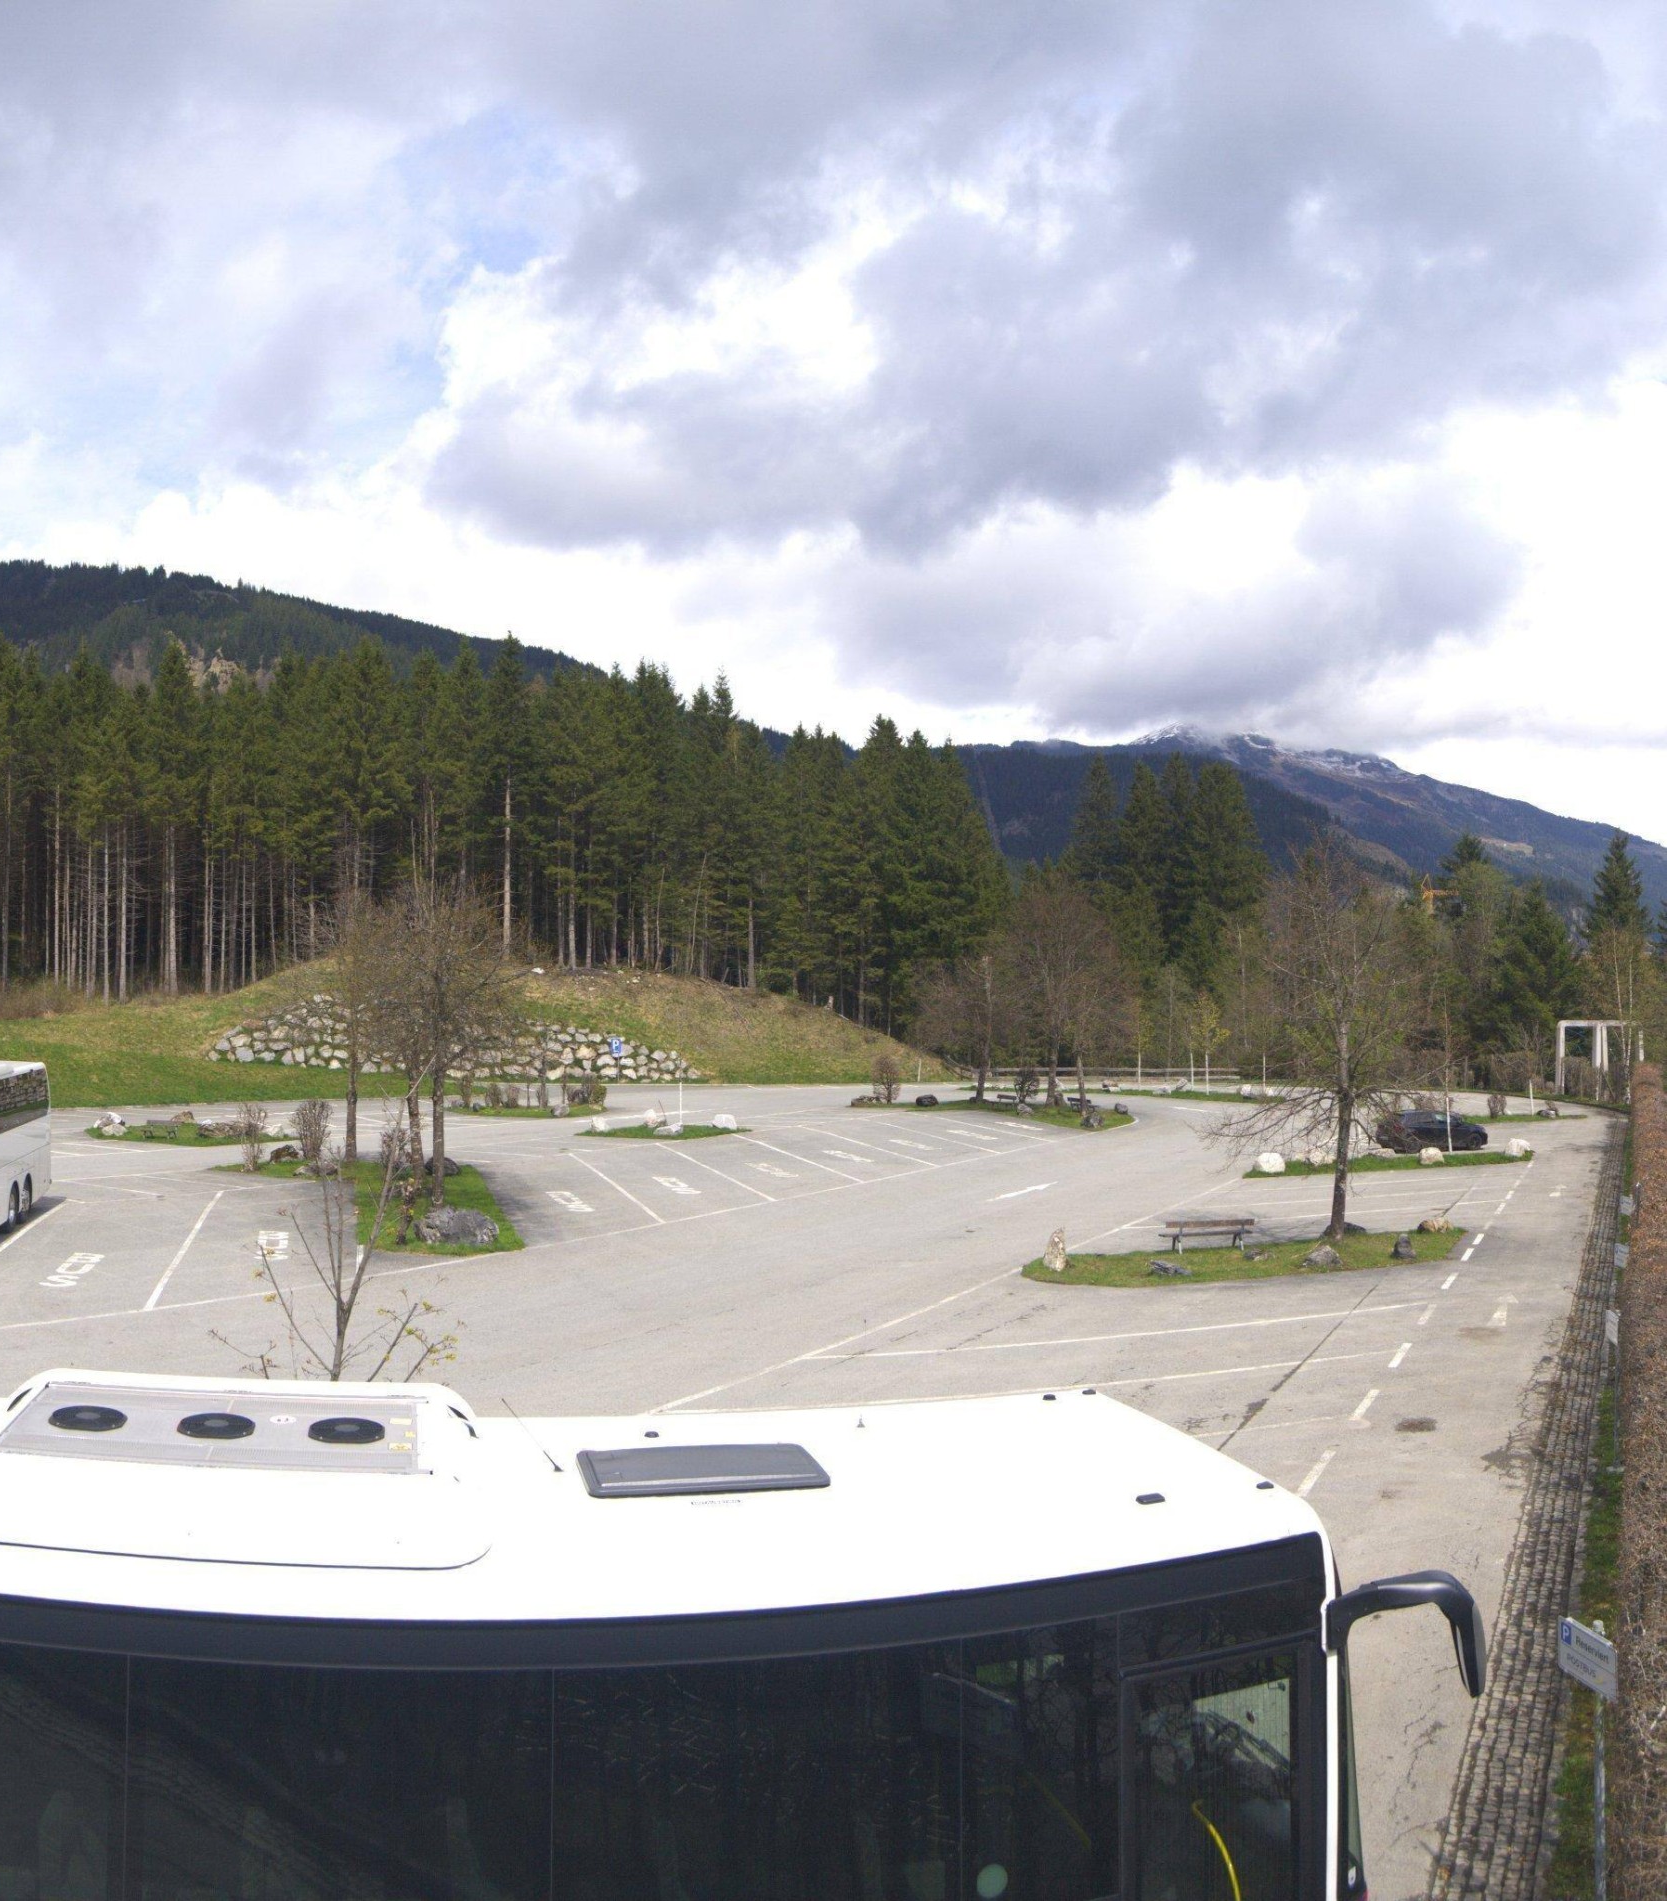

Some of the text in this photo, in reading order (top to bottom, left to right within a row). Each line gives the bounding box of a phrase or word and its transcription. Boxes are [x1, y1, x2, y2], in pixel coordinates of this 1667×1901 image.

[38, 1252, 105, 1287] BUS
[1562, 1624, 1609, 1664] P Reserviert
